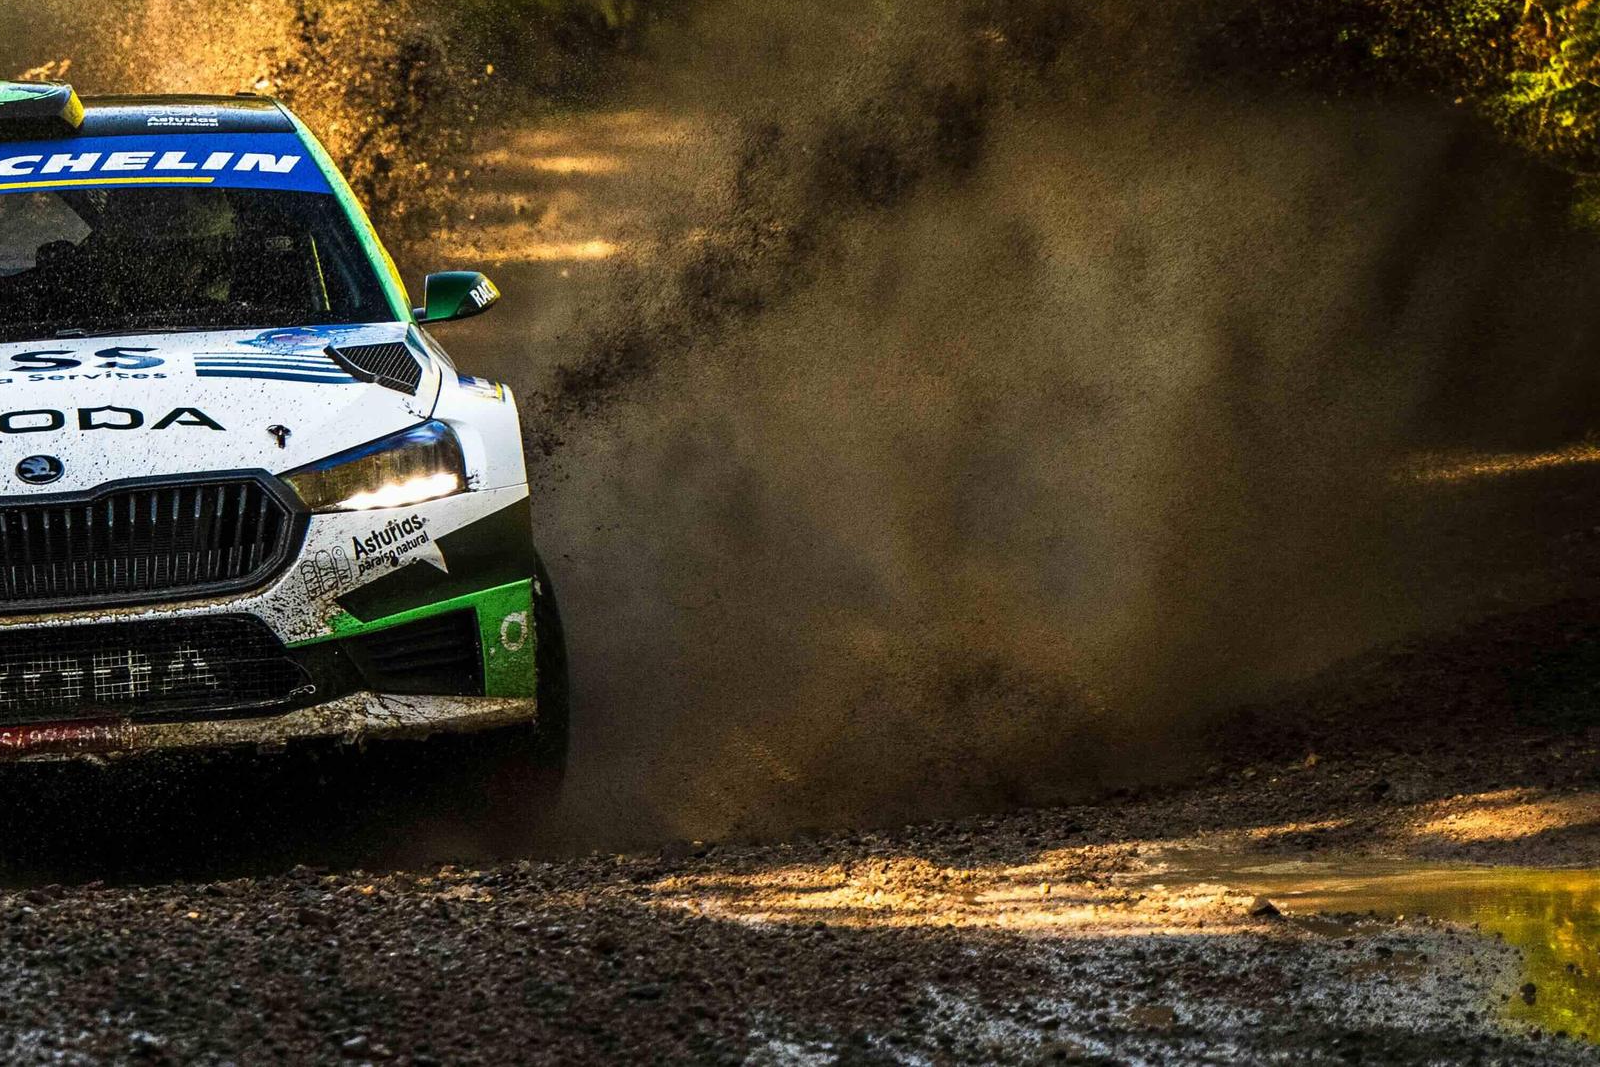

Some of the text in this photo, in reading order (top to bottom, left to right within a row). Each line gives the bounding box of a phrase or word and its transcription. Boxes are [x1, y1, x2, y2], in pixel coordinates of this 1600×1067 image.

[28, 370, 167, 382] Services
[352, 513, 423, 561] Asturias
[395, 530, 430, 555] natural
